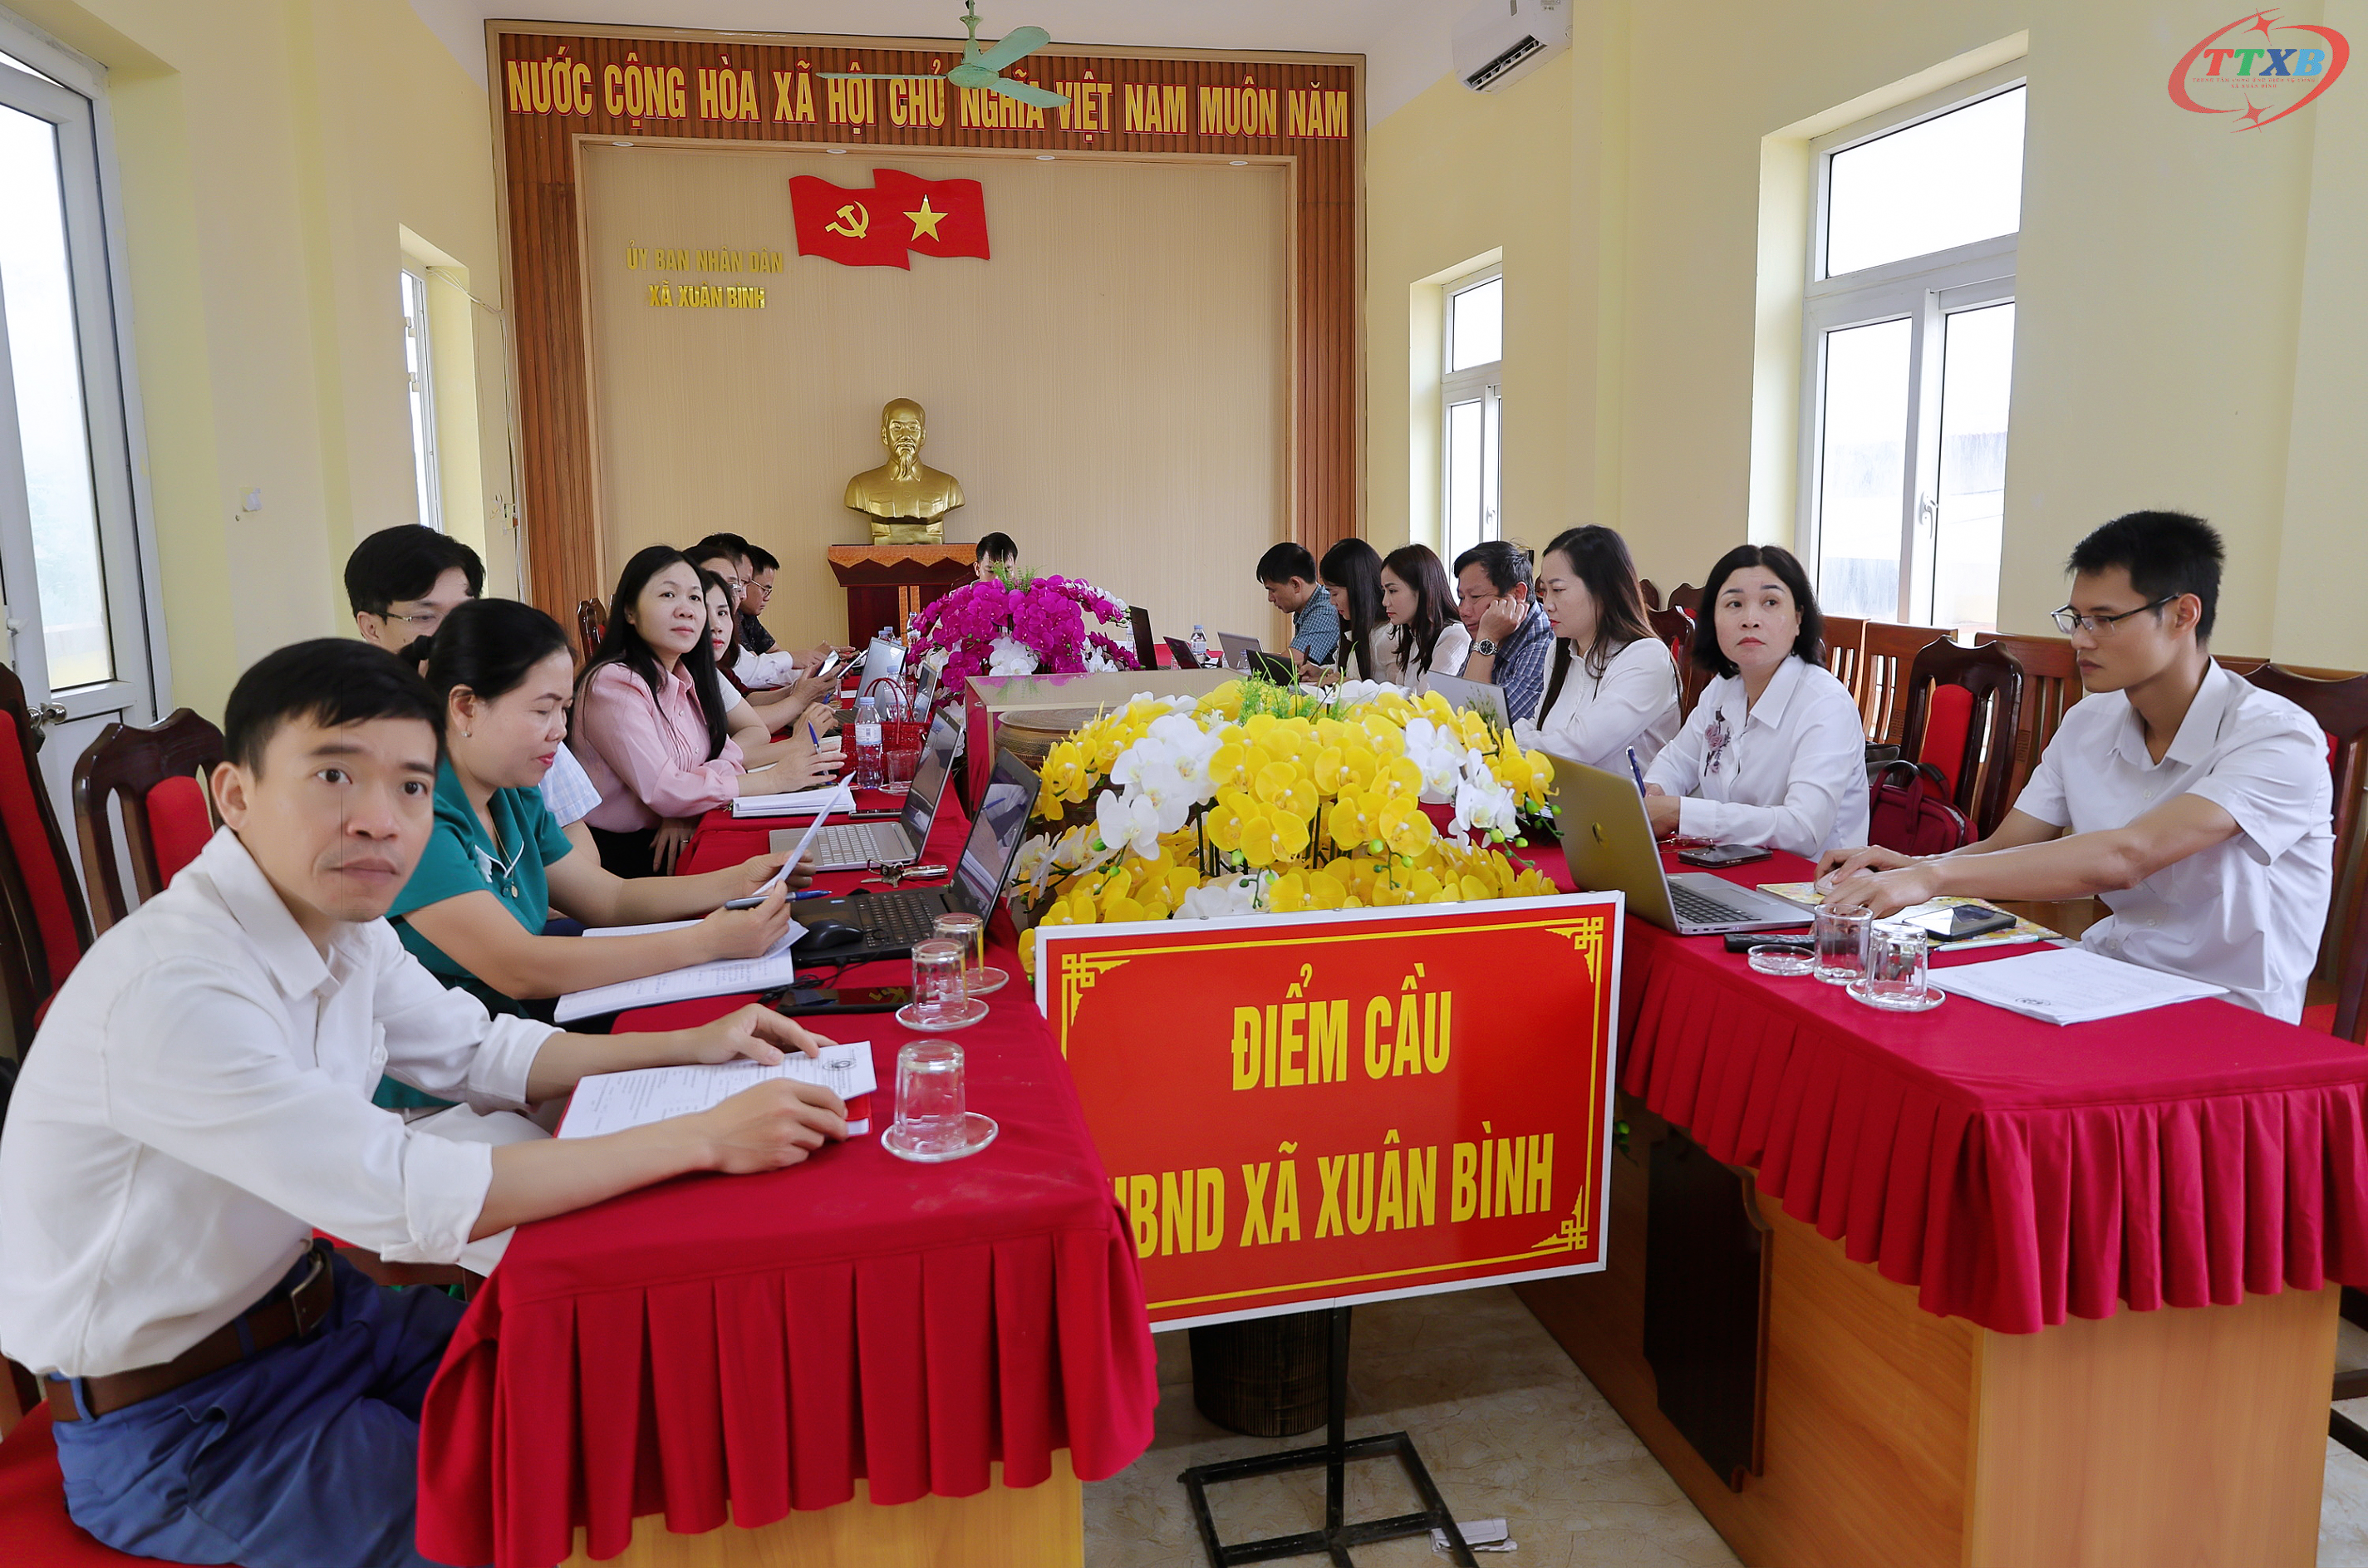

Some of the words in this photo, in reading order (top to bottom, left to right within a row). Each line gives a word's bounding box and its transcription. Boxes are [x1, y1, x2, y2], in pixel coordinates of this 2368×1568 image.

[507, 46, 593, 117] NƯỚC
[604, 52, 686, 130] CỘNG
[697, 54, 760, 122] HÒA
[774, 59, 817, 124] XÃ
[828, 59, 876, 135] HỘI
[889, 58, 946, 128] CHỦ
[1055, 68, 1113, 143] VIỆT
[1124, 83, 1188, 135] NAM
[1197, 74, 1278, 138] MUÔN
[1286, 81, 1349, 139] NĂM
[626, 239, 649, 270] ỦY
[655, 248, 690, 272] BAN
[695, 245, 743, 273] NHÂN
[749, 246, 784, 273] DÂN
[648, 279, 673, 307] XÃ
[677, 281, 724, 308] XUÂN
[726, 281, 765, 309] BÌNH
[1231, 962, 1348, 1091] ĐIỂM
[1363, 962, 1452, 1081] CẦU
[1240, 1141, 1301, 1246] XÃ
[1314, 1129, 1438, 1241] XUÂN
[1451, 1121, 1555, 1223] BÌNH
